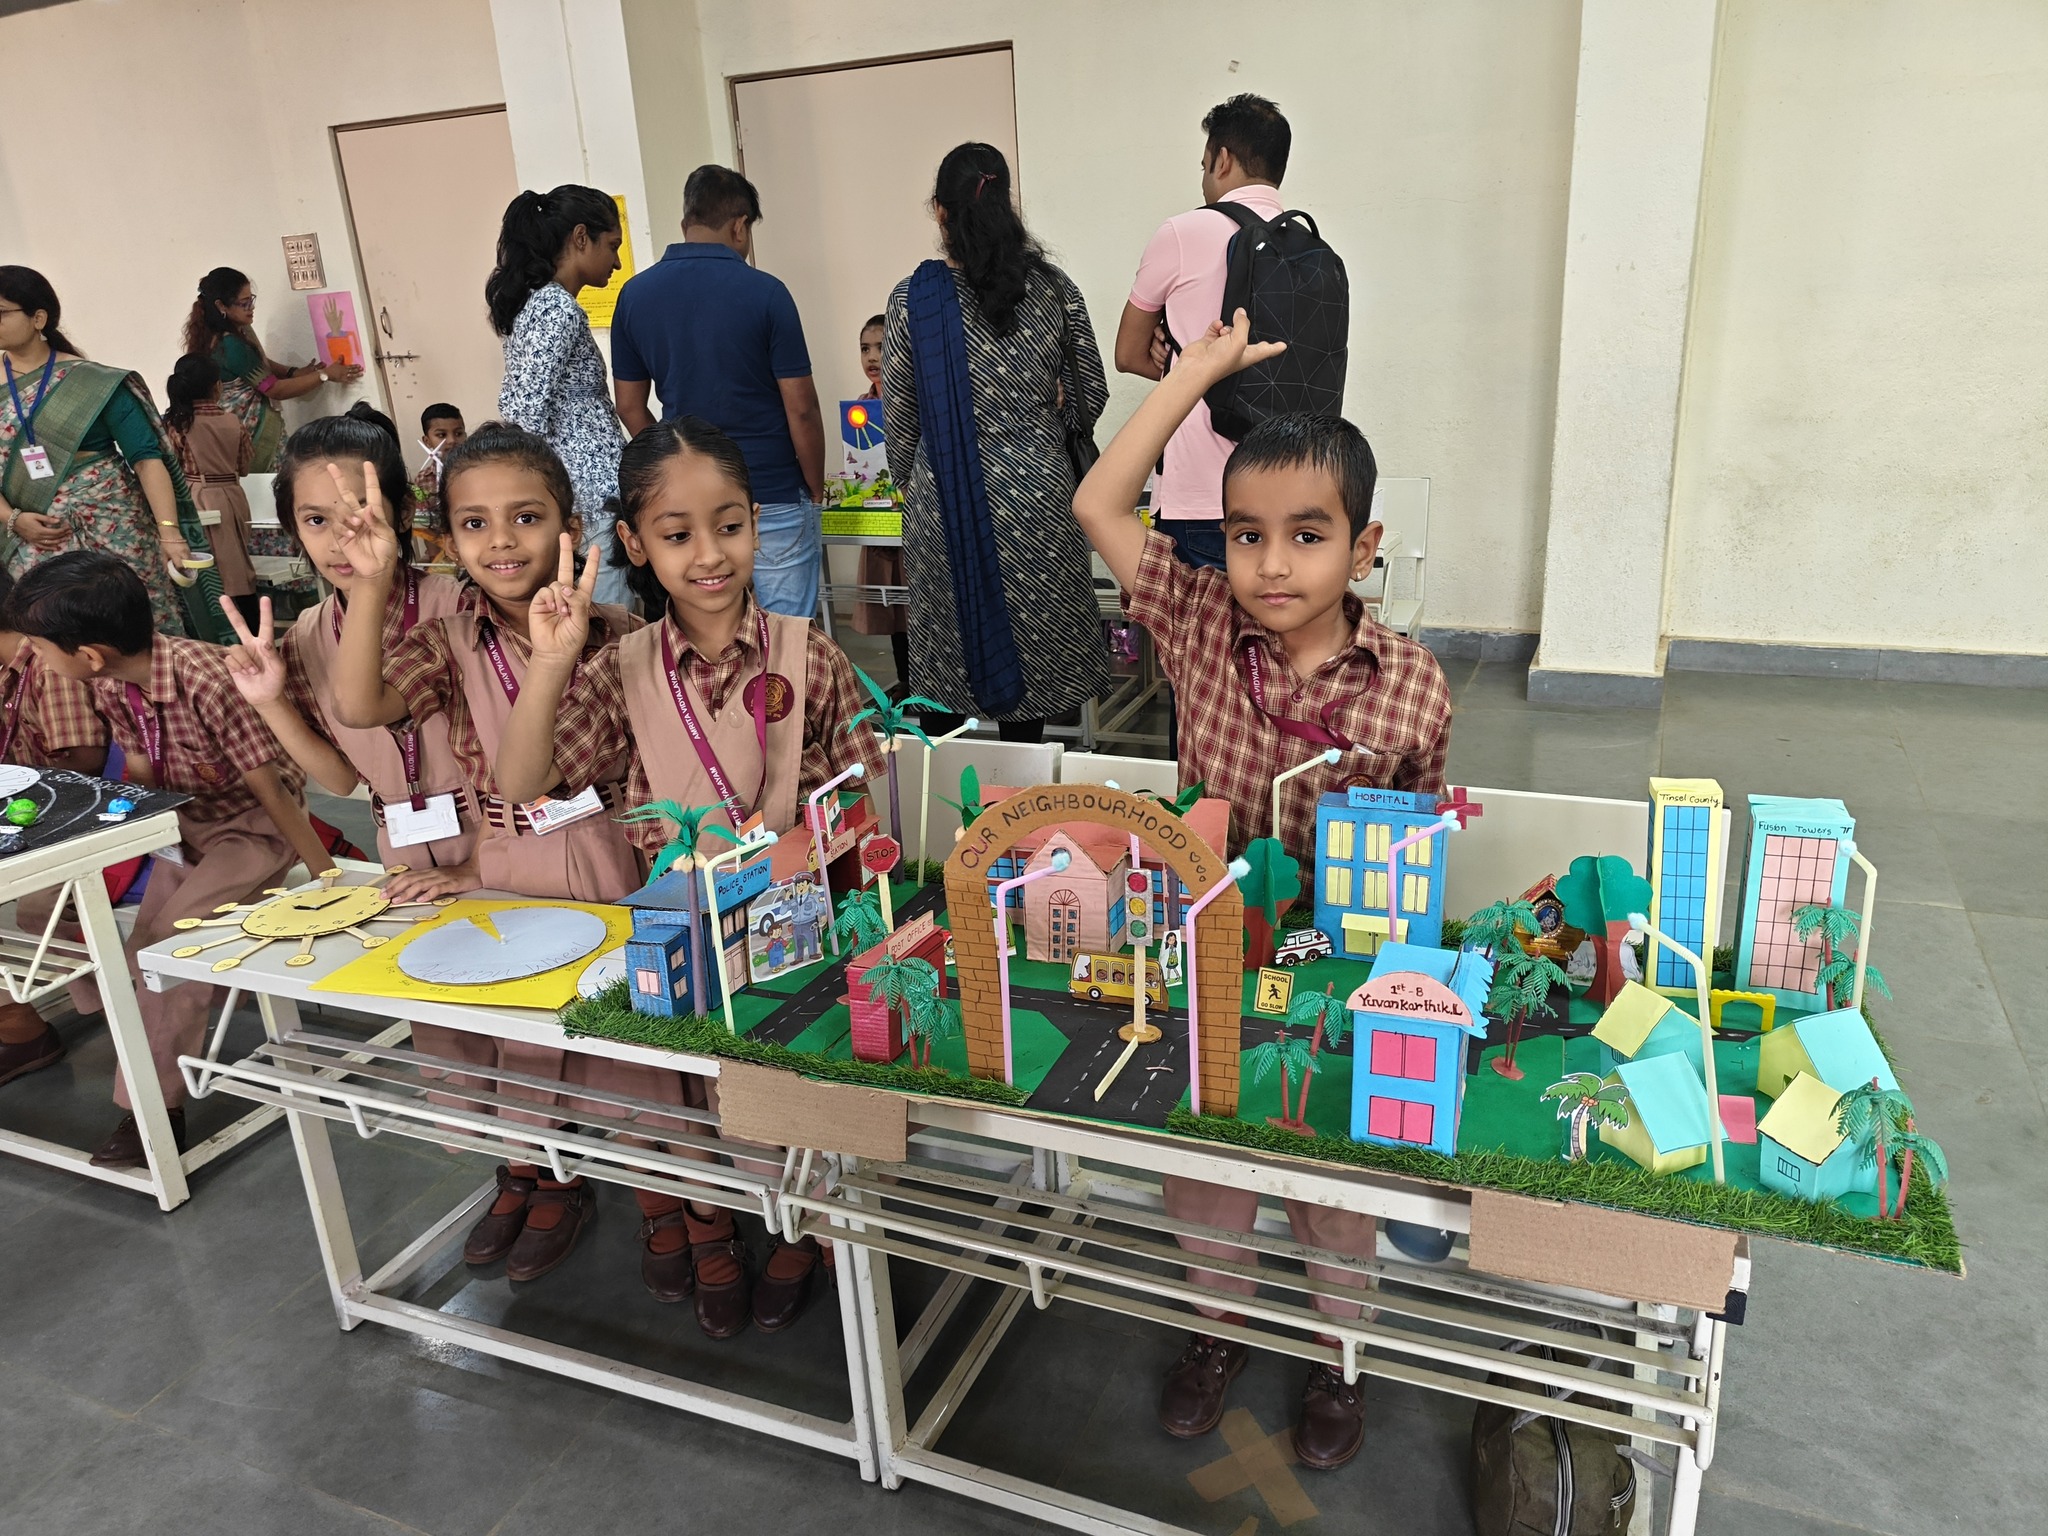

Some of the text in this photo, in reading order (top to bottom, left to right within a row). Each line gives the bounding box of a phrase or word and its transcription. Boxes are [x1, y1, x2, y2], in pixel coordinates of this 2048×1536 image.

[491, 649, 514, 691] VIDYALAYAM
[1248, 646, 1261, 693] VIDYALAYAM
[669, 670, 700, 740] AMRITA VIDYALAYAM
[1355, 792, 1409, 806] HOSPITAL
[1658, 793, 1721, 808] Tinsel County
[960, 793, 1188, 870] OUR NEIGHBOURHOOD
[1758, 821, 1787, 832] Fusion
[1795, 824, 1832, 836] Towers
[830, 840, 849, 858] STATION
[866, 846, 896, 862] STOP
[718, 864, 768, 897] POLICE STATION
[890, 920, 926, 954] POST OFFICE
[524, 942, 594, 972] Wheel
[1264, 974, 1289, 984] SCHOOL
[1416, 986, 1424, 997] B
